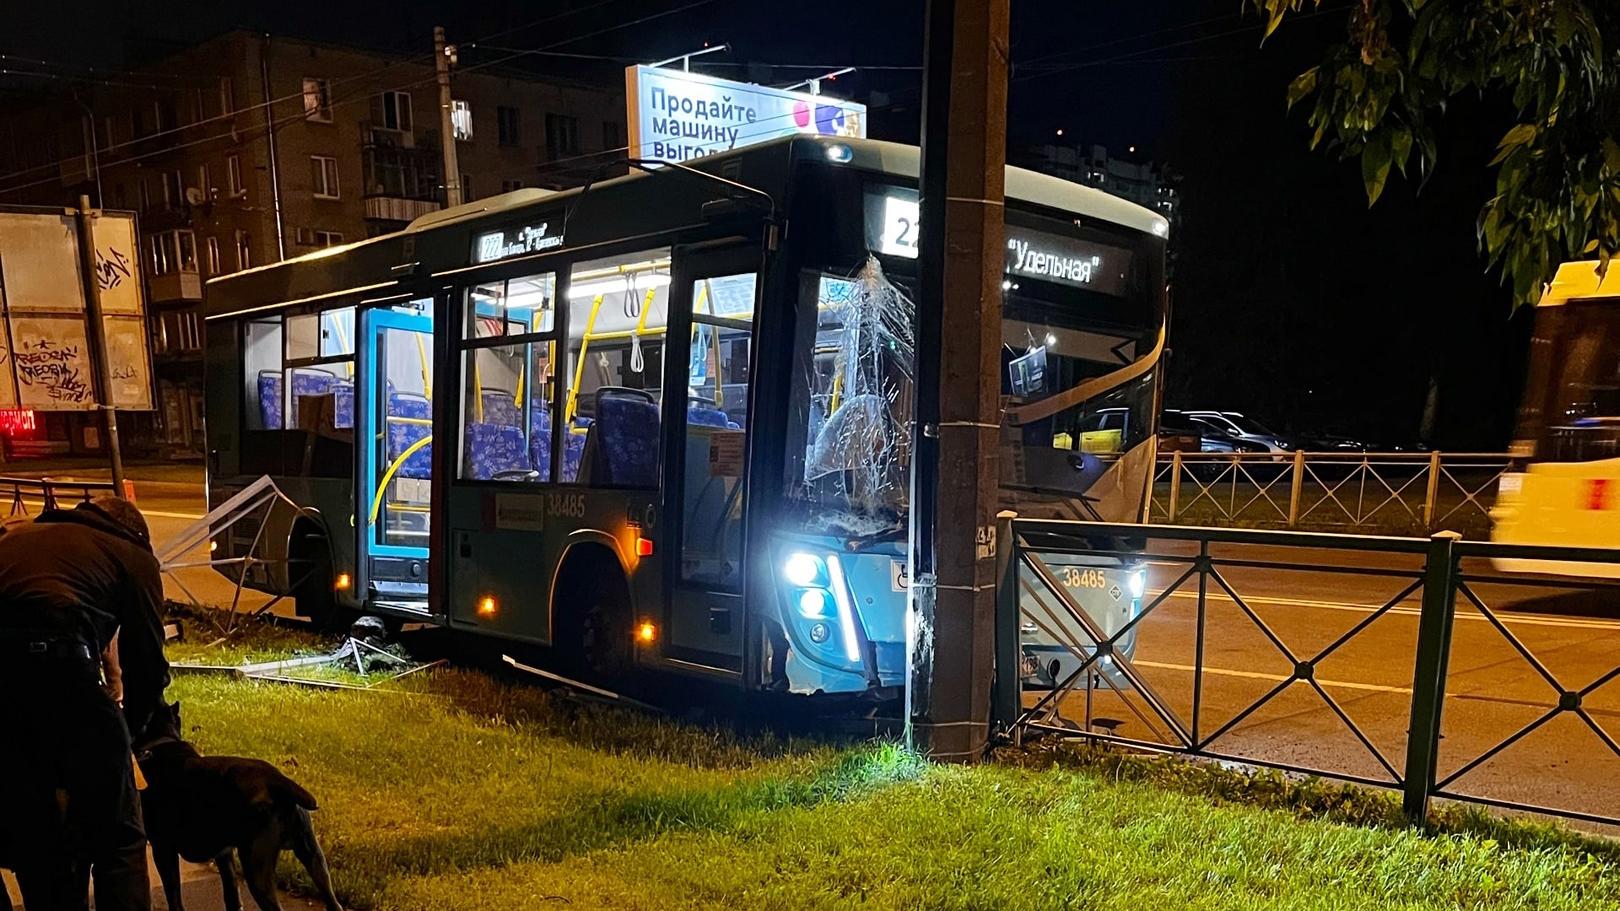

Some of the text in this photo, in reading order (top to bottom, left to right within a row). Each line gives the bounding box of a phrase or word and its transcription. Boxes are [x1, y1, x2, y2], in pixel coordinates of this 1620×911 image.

[651, 86, 757, 124] Продайте
[653, 116, 739, 149] машину
[545, 493, 586, 518] 38485
[1063, 568, 1106, 589] 38485
